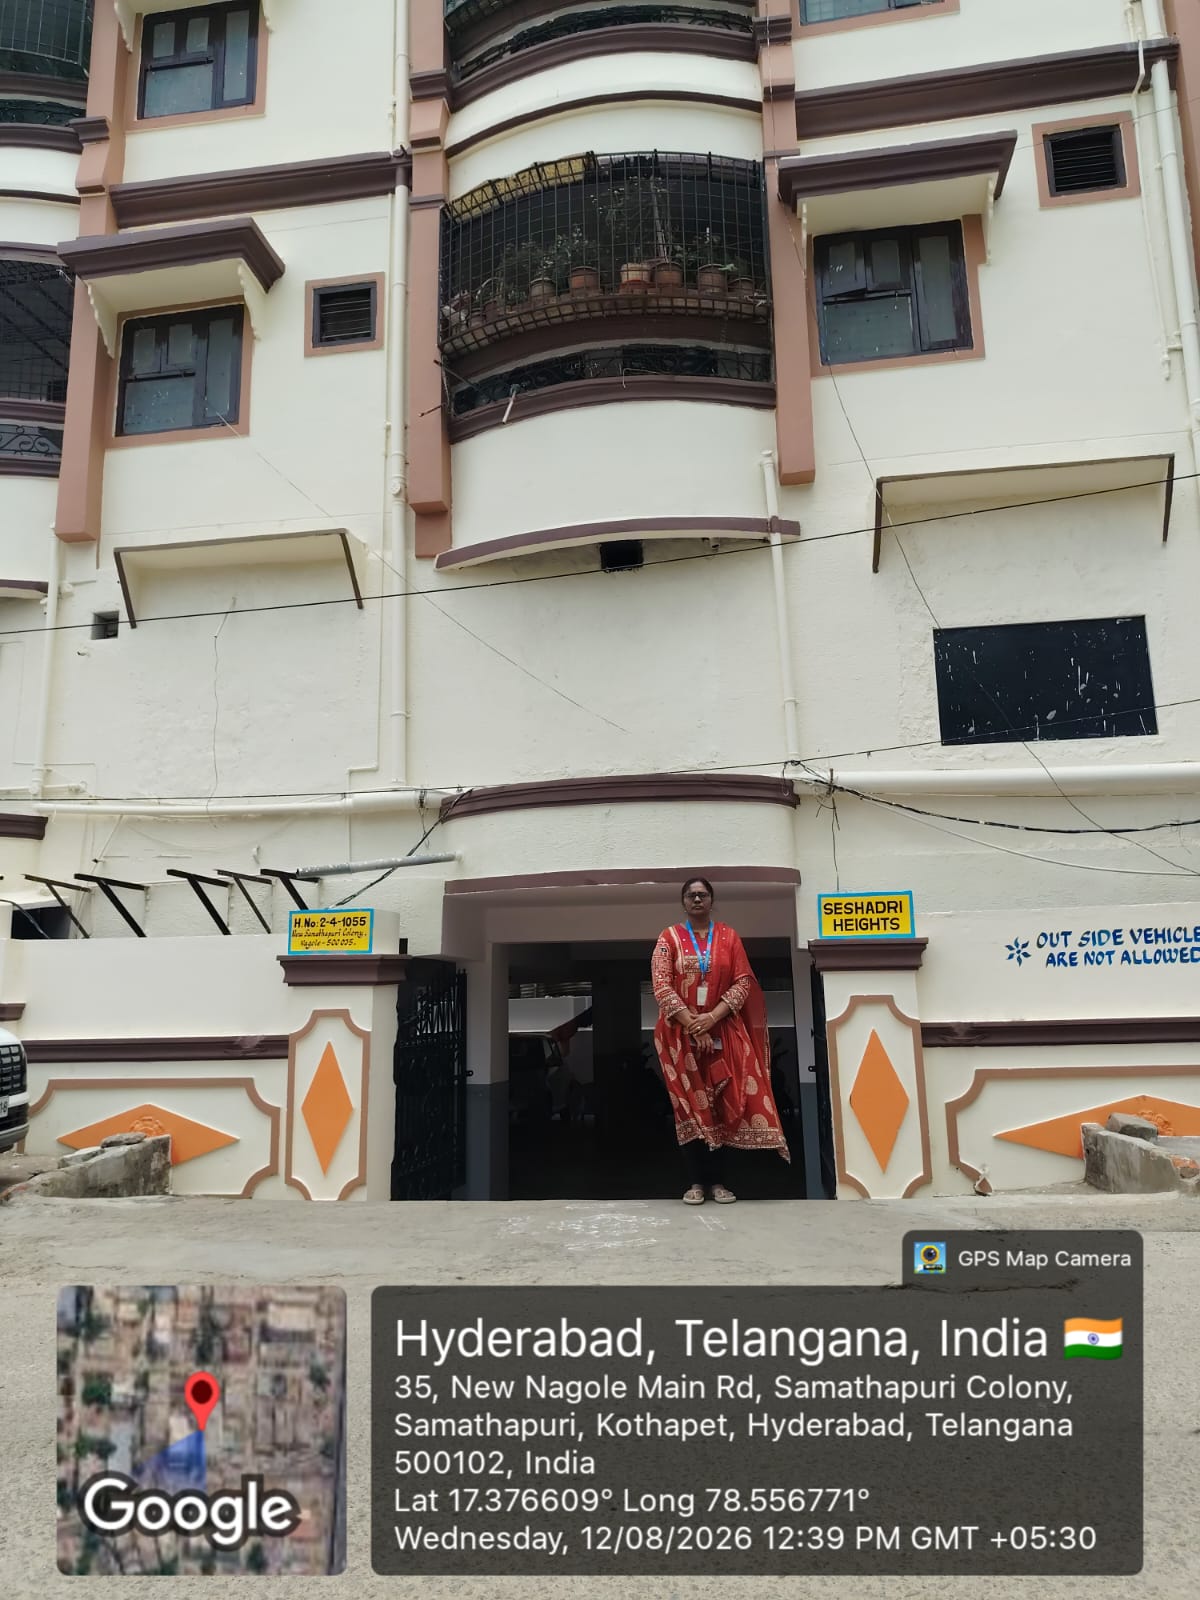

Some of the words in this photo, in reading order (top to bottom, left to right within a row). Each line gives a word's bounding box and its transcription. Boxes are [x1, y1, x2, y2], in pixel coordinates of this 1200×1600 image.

[823, 900, 903, 915] SESHADRI
[833, 917, 900, 931] HEIGHTS
[292, 929, 303, 938] New
[1036, 931, 1073, 949] OUT
[1078, 929, 1124, 947] SIDE
[301, 939, 321, 949] Nagole
[1046, 951, 1078, 968] ARE
[1084, 950, 1116, 966] NOT
[1121, 947, 1200, 965] ALLOWED
